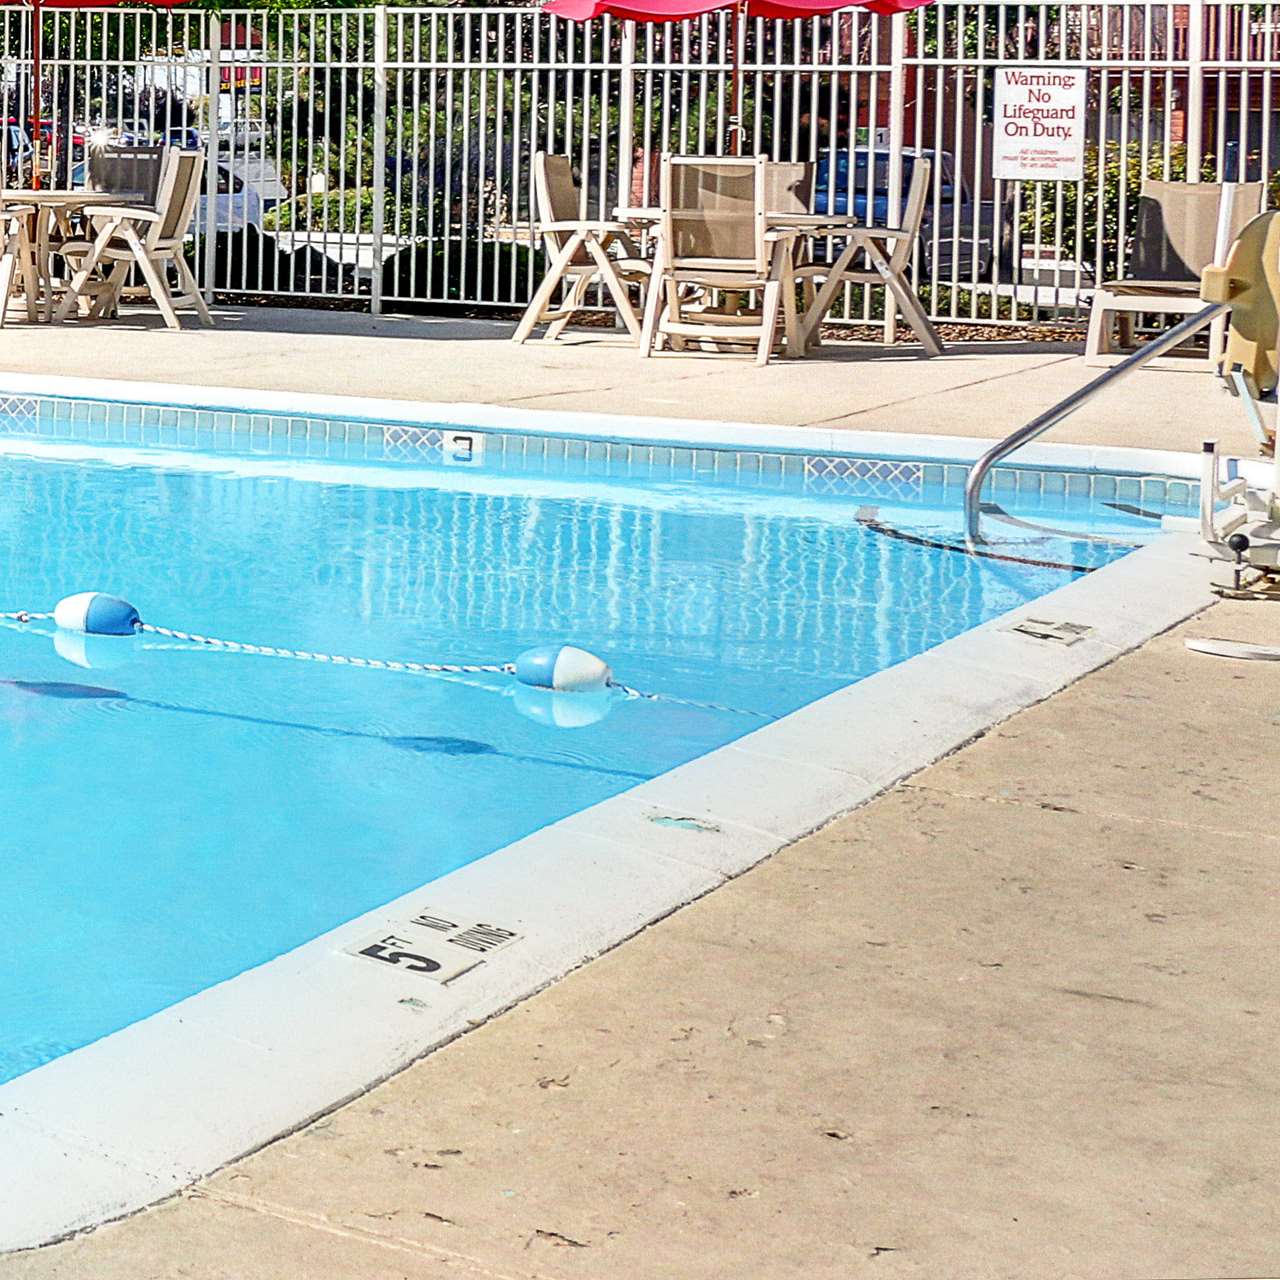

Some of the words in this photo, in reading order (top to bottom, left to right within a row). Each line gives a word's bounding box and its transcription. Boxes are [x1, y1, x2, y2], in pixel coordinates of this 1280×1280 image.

[1005, 71, 1076, 90] Warning:
[1027, 89, 1051, 103] No
[1003, 104, 1076, 122] Lifeguard
[1004, 122, 1028, 136] On
[1034, 122, 1072, 140] Duty.
[410, 914, 460, 934] NO
[380, 934, 414, 950] FT
[445, 923, 518, 953] DIVING
[358, 943, 443, 973] 5
